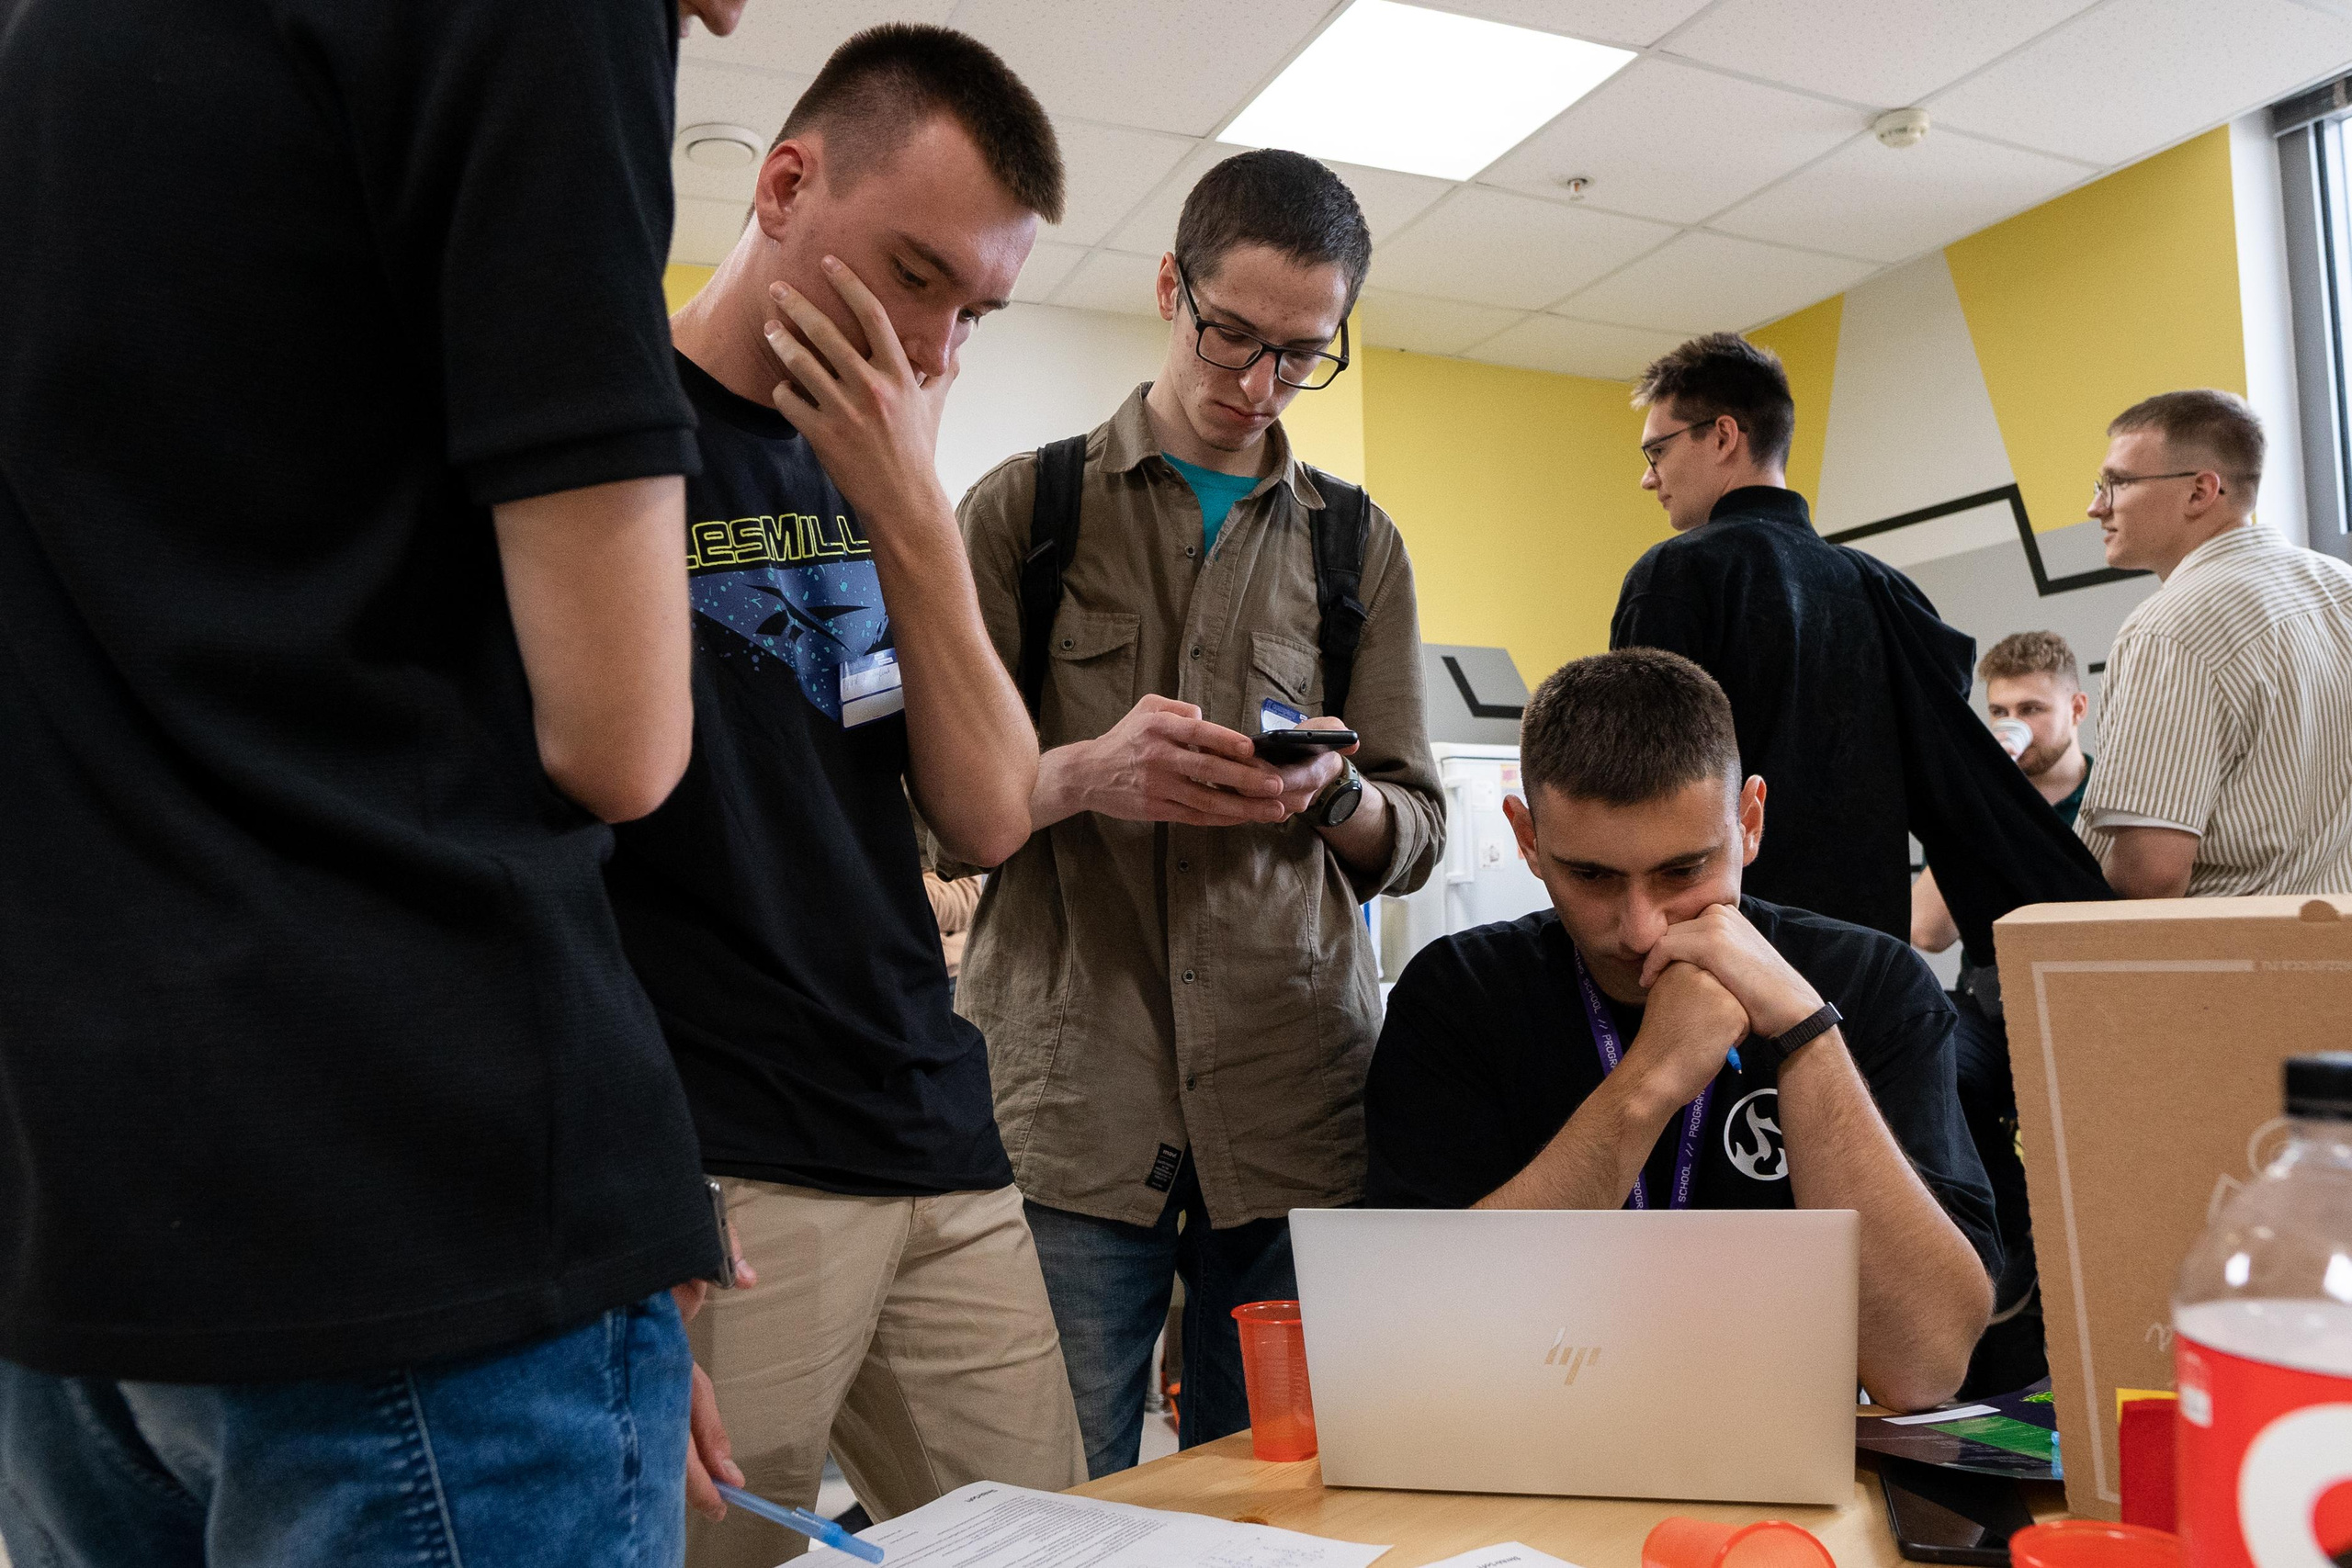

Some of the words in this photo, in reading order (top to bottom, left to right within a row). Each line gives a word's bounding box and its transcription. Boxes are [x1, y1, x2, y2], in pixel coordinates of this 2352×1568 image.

[1582, 978, 1601, 1014] SCHOOL
[1678, 1163, 1691, 1202] SCHOOL
[1544, 1325, 1601, 1386] hp
